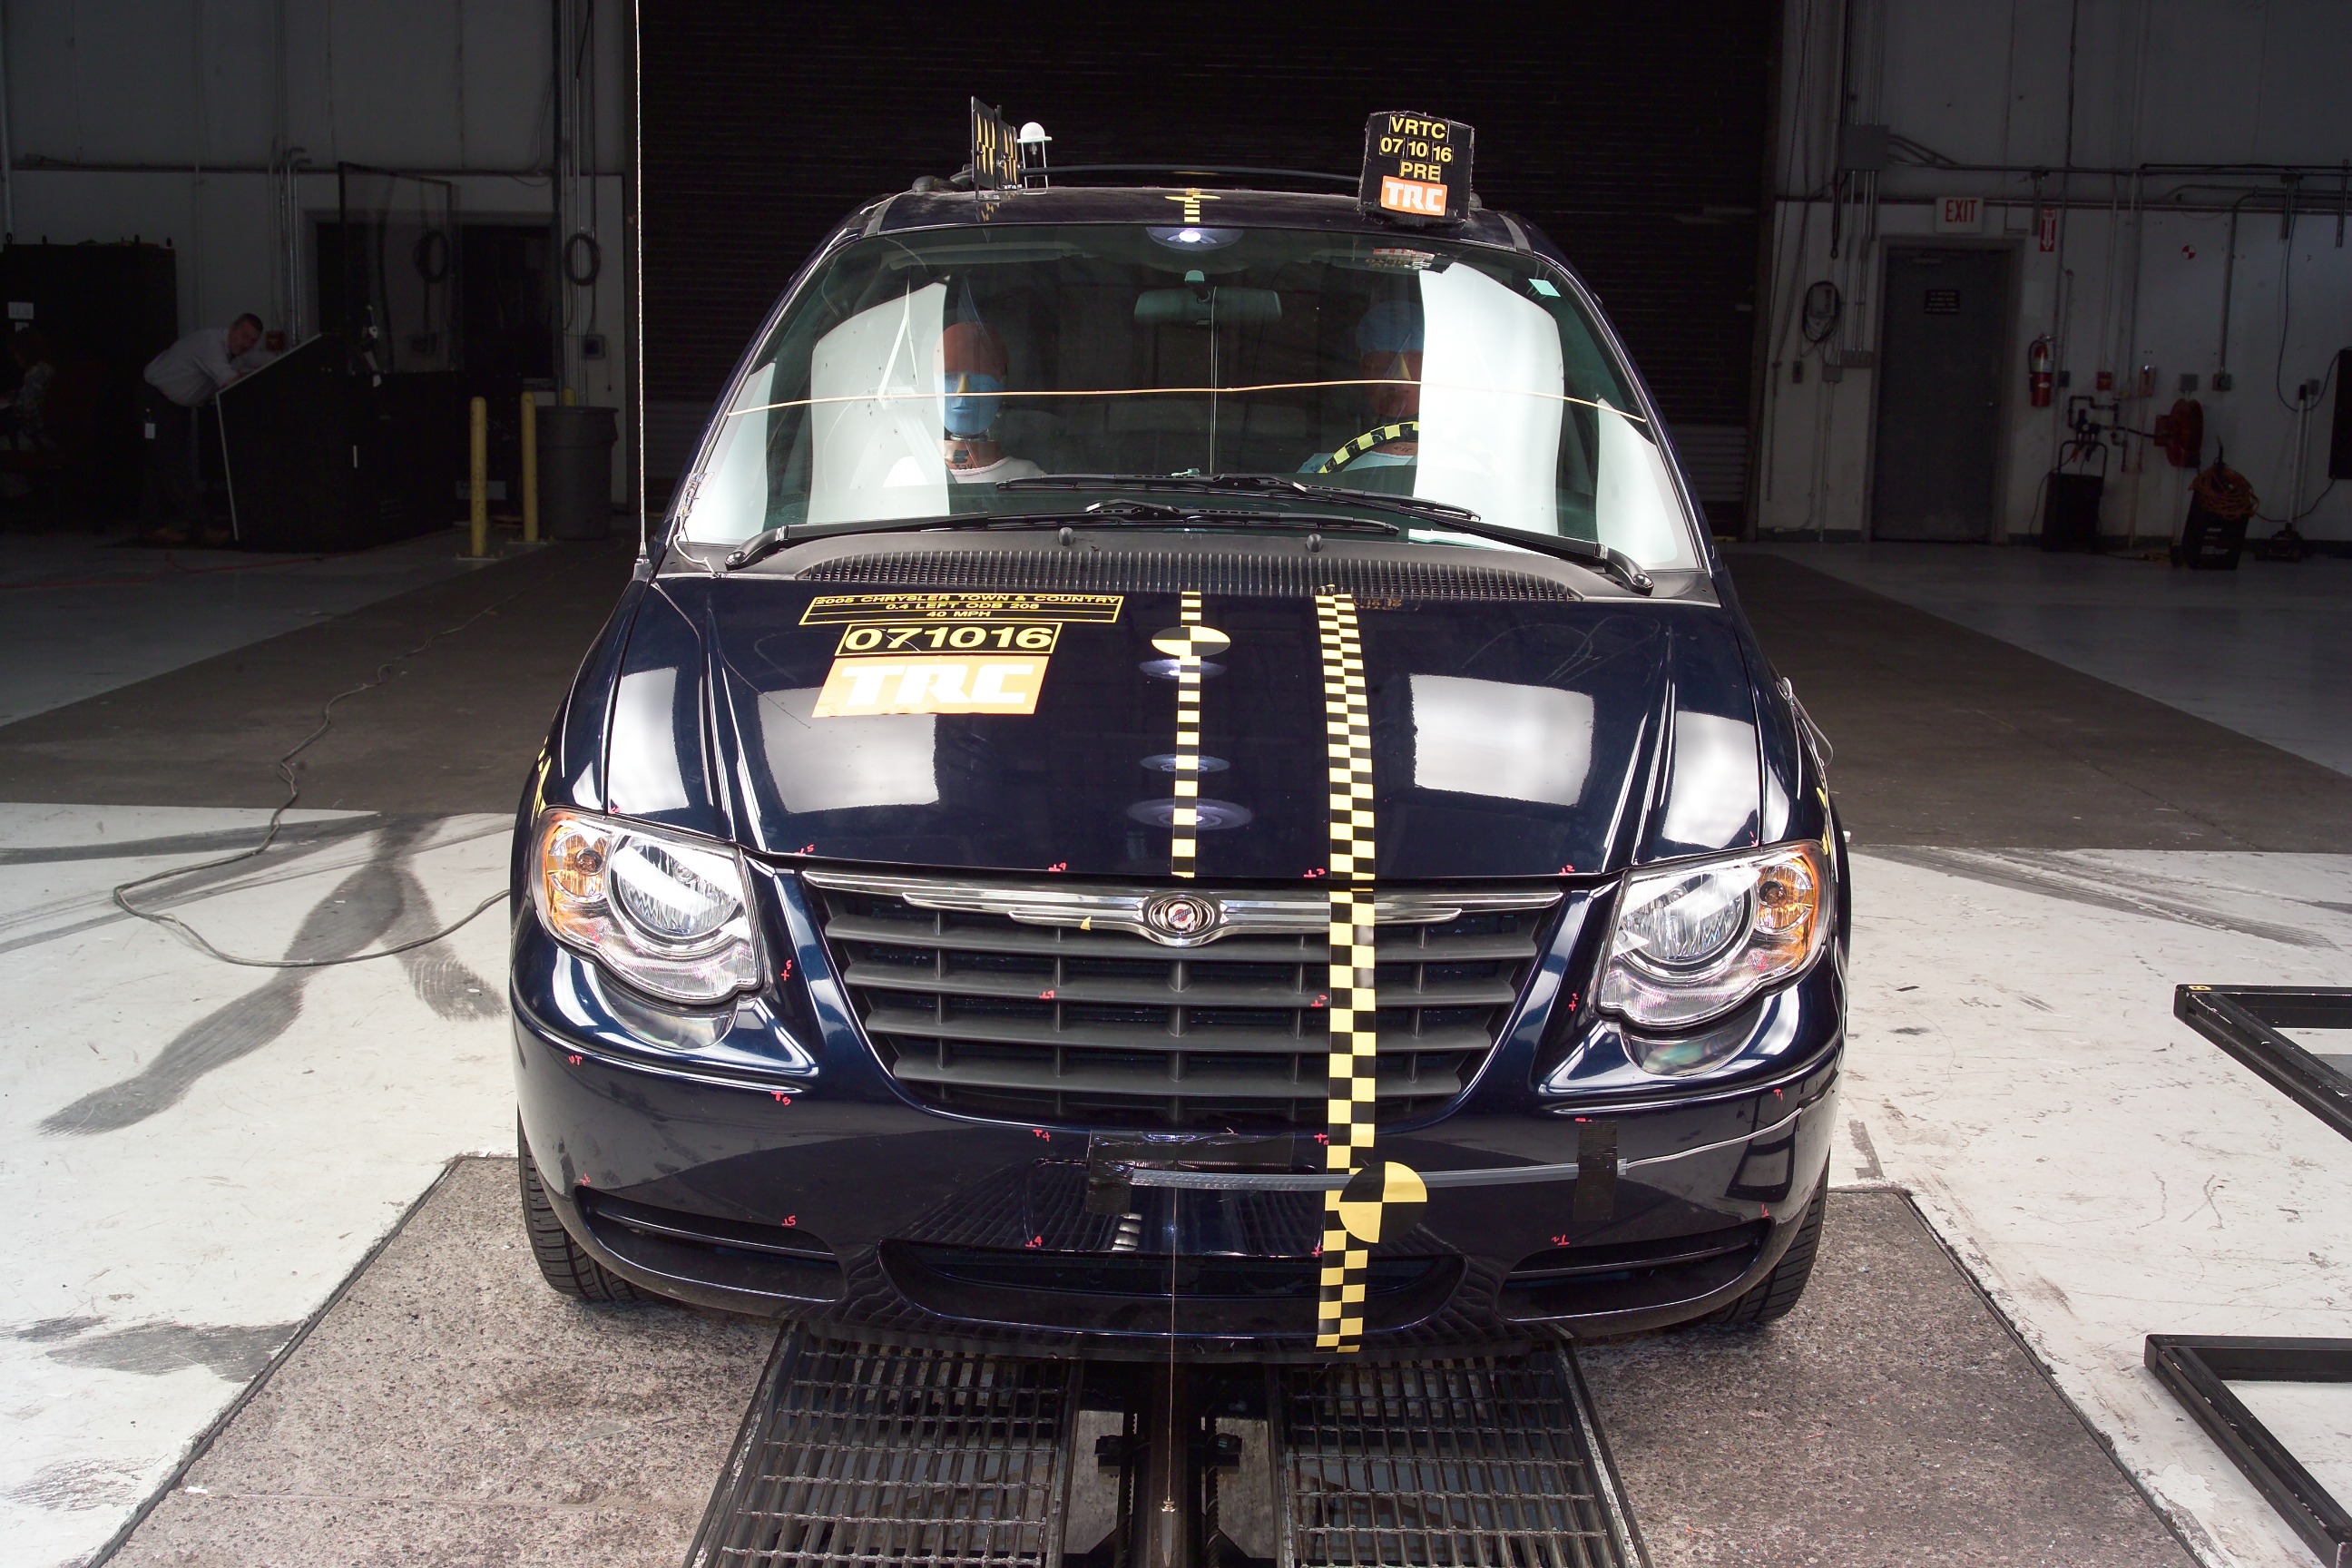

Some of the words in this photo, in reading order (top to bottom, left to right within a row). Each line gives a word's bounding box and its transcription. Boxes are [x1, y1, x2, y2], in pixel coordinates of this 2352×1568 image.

[1391, 116, 1446, 139] VRTC
[1380, 137, 1404, 153] 07
[1408, 141, 1428, 157] 10
[1433, 145, 1452, 162] 16
[1400, 162, 1440, 181] PRE
[1385, 181, 1443, 212] TRC
[1945, 200, 1977, 222] EXIT
[860, 594, 950, 603] CHRYSLER
[1034, 595, 1119, 603] COUNTRY
[844, 626, 1054, 651] 071016
[839, 663, 1034, 706] TRC
